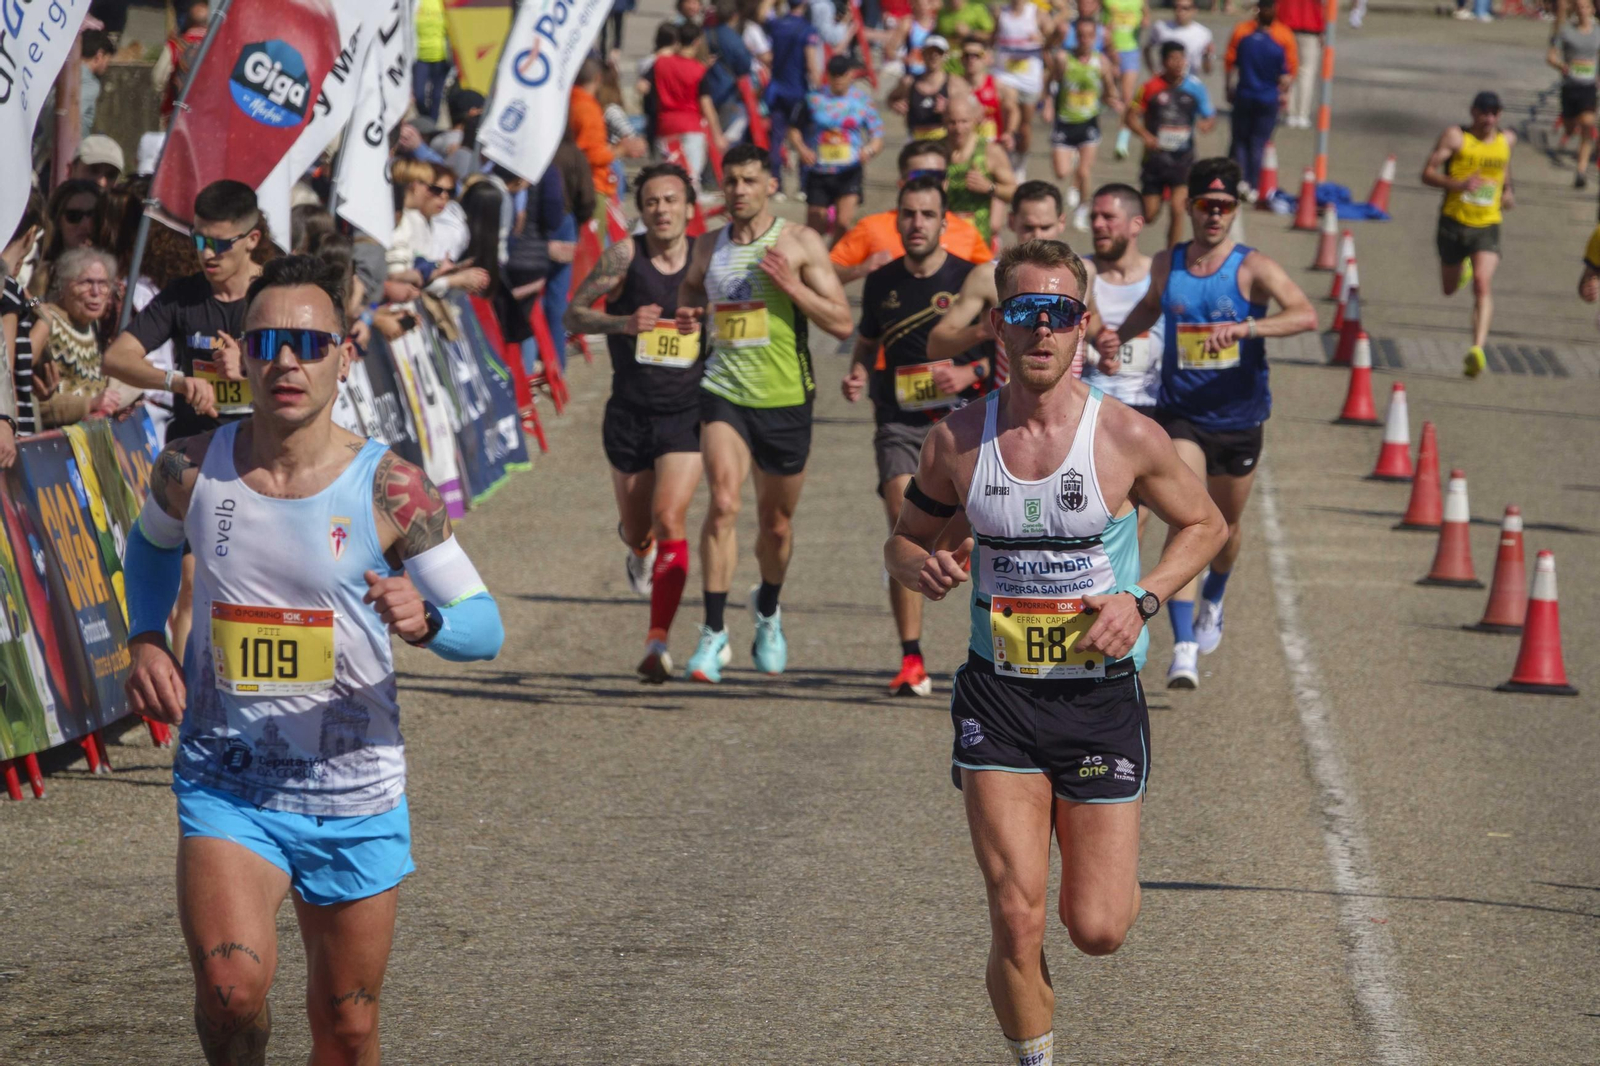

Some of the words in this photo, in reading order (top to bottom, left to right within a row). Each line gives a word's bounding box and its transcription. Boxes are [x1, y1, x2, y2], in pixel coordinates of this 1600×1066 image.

[243, 51, 307, 108] Giga
[725, 317, 747, 338] 77
[657, 335, 680, 357] 96
[1016, 556, 1094, 574] HYUNDAI
[1041, 578, 1094, 594] SANTIAGO
[1045, 616, 1077, 624] CAPELO
[257, 627, 281, 636] PITI
[1026, 627, 1067, 662] 68
[240, 637, 298, 678] 109
[1079, 765, 1109, 778] one
